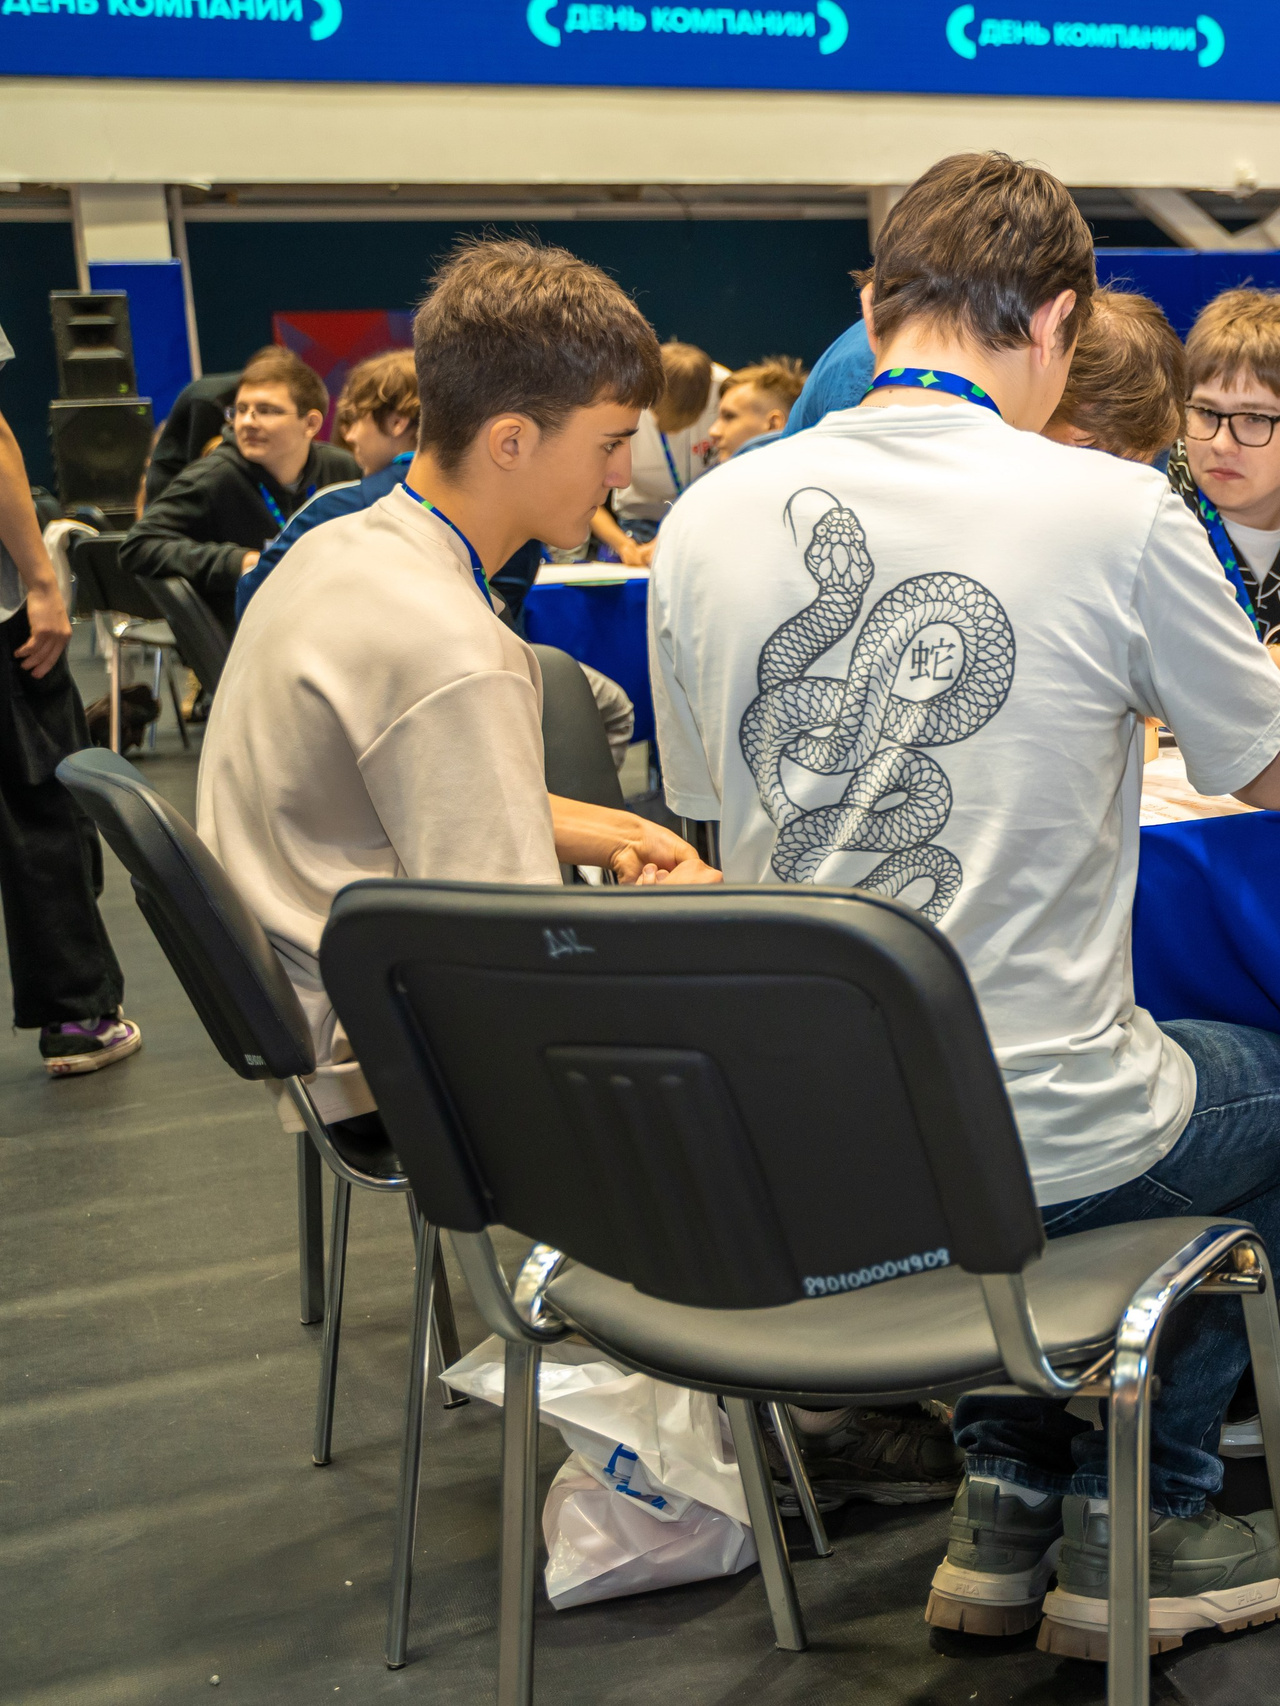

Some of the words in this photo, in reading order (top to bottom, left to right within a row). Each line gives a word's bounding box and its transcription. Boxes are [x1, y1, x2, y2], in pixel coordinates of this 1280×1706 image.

[564, 3, 646, 33] ДЕНЬ
[651, 6, 815, 37] КОМПАНИИ
[978, 19, 1050, 46] ДЕНЬ
[1053, 22, 1196, 51] КОМПАНИИ
[909, 637, 956, 682] 蛇
[955, 1583, 980, 1596] FILA
